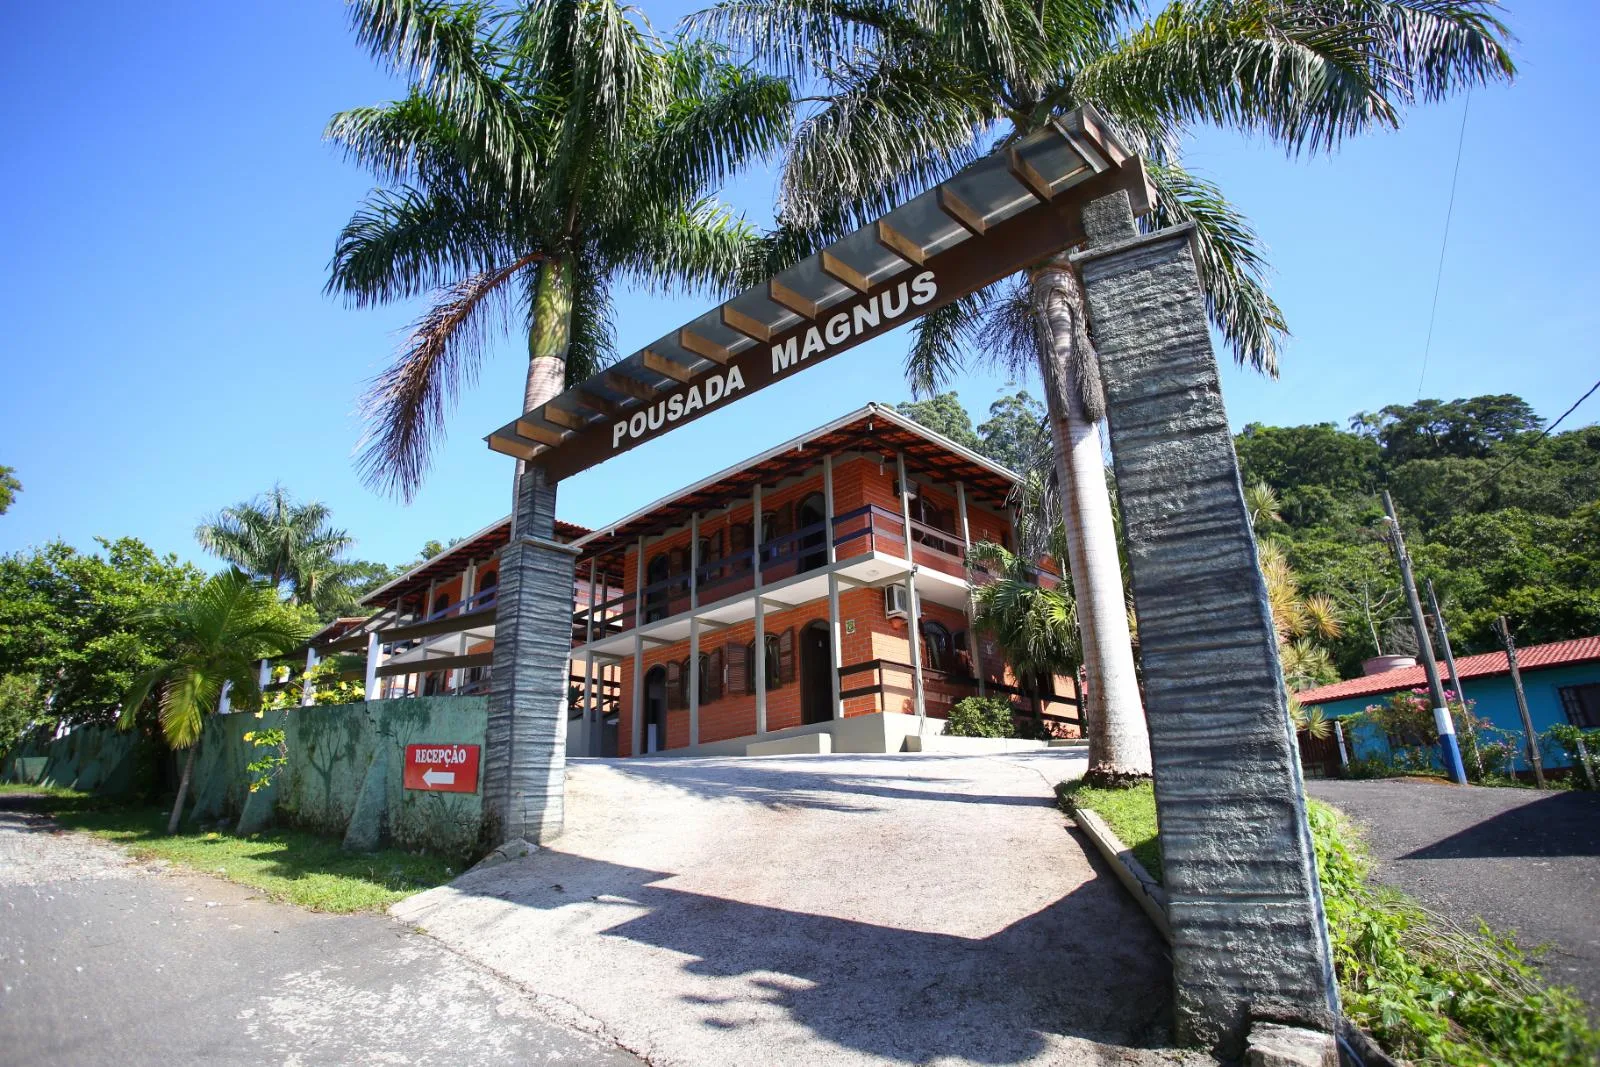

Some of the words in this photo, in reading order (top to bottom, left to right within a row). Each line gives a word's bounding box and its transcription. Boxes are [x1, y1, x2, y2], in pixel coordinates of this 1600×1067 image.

[612, 365, 745, 448] POUSADA
[771, 271, 938, 374] MAGNUS
[415, 745, 467, 767] RECEPÇÃO
